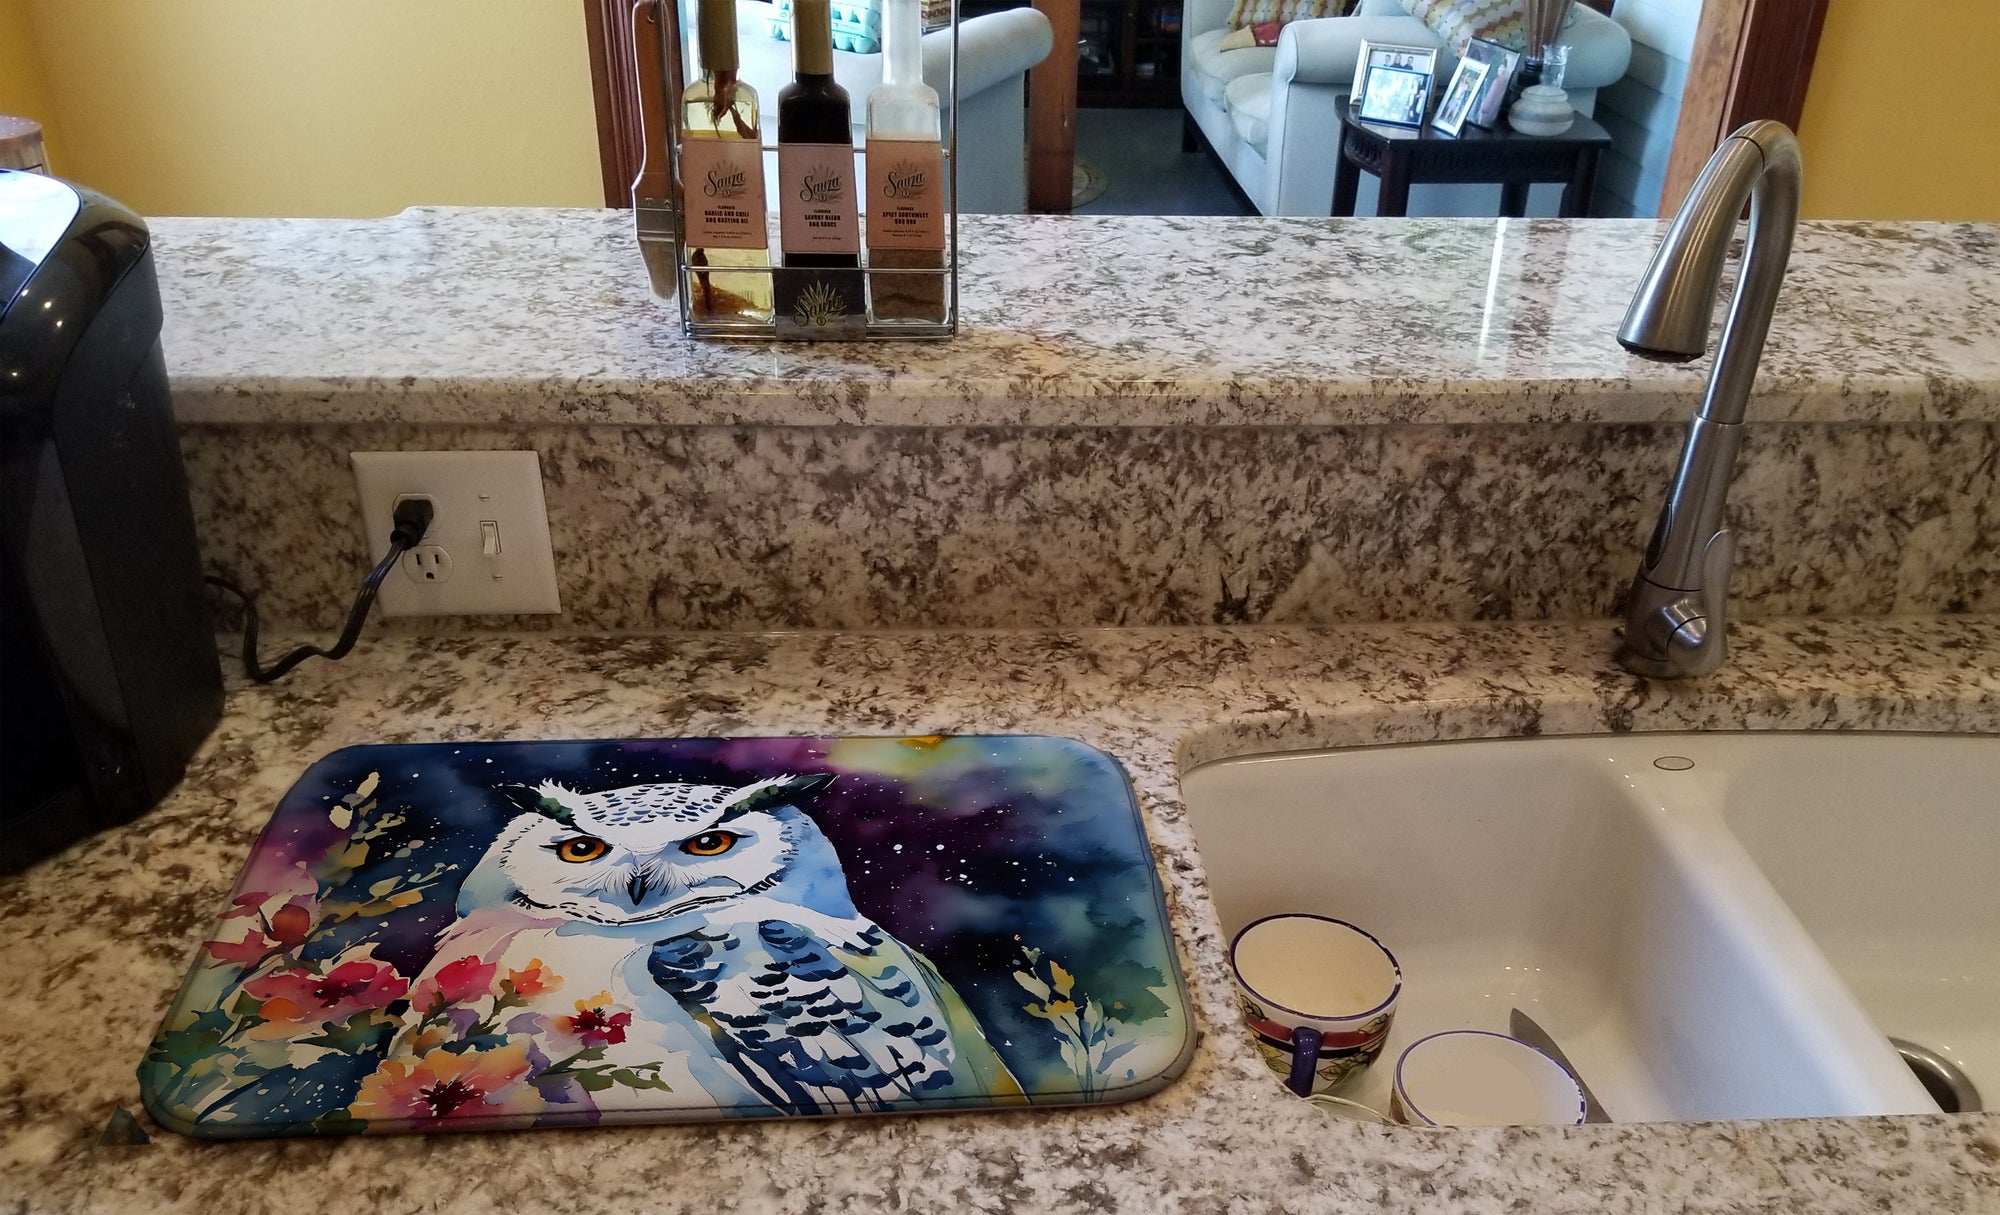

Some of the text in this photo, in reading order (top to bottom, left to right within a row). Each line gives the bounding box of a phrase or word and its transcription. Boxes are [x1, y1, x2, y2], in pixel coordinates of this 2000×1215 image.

[703, 170, 745, 197] Sauza
[800, 175, 841, 202] Sauza
[883, 171, 925, 198] Sauza
